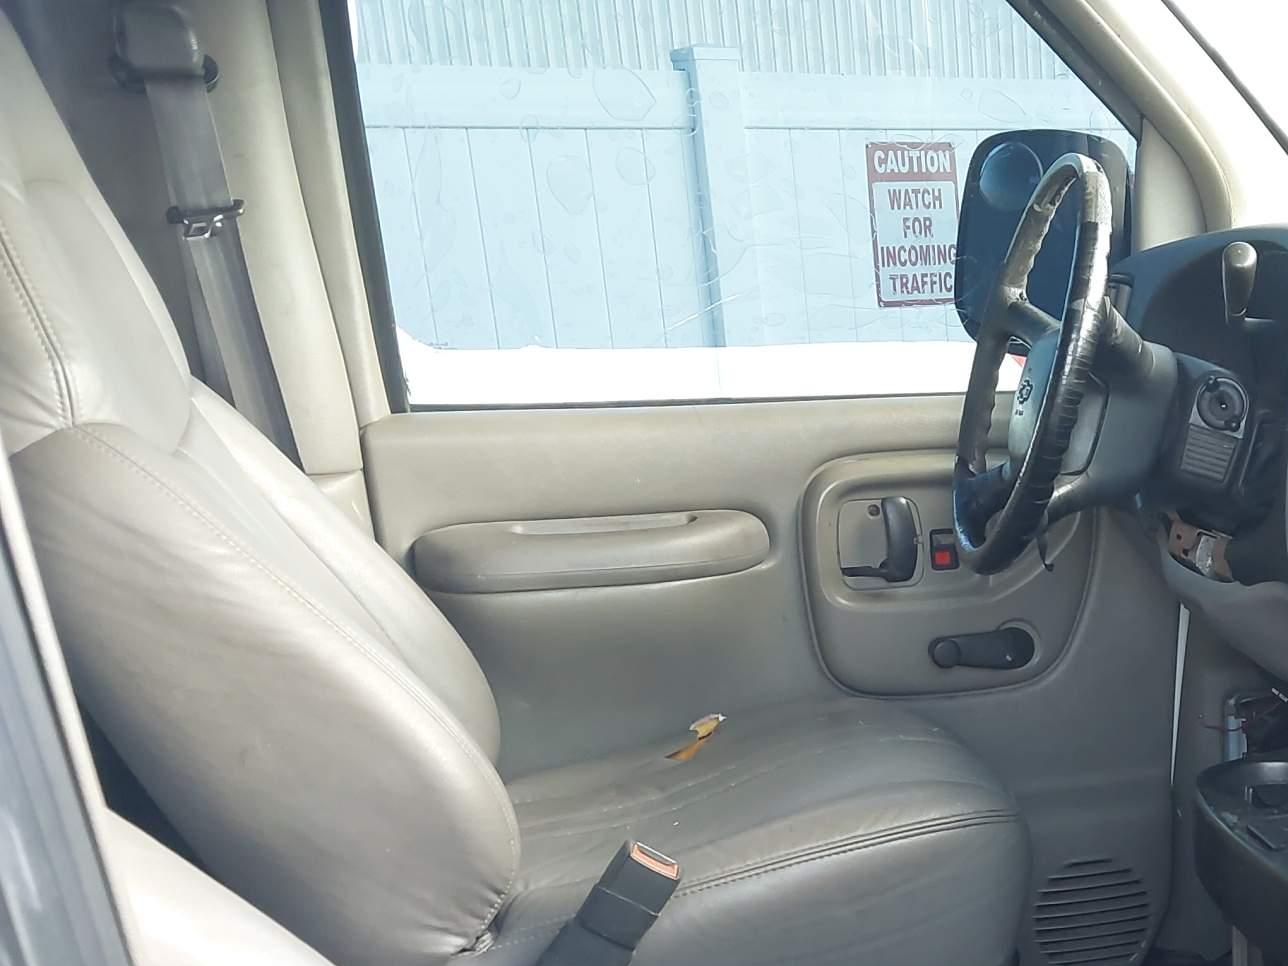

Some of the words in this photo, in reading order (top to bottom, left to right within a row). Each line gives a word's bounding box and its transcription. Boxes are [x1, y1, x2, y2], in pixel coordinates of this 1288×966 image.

[873, 150, 951, 174] CAUTION
[888, 187, 943, 211] WATCH
[902, 216, 934, 239] FOR
[880, 243, 957, 268] INCOMING
[889, 271, 953, 296] TRAFFIC
